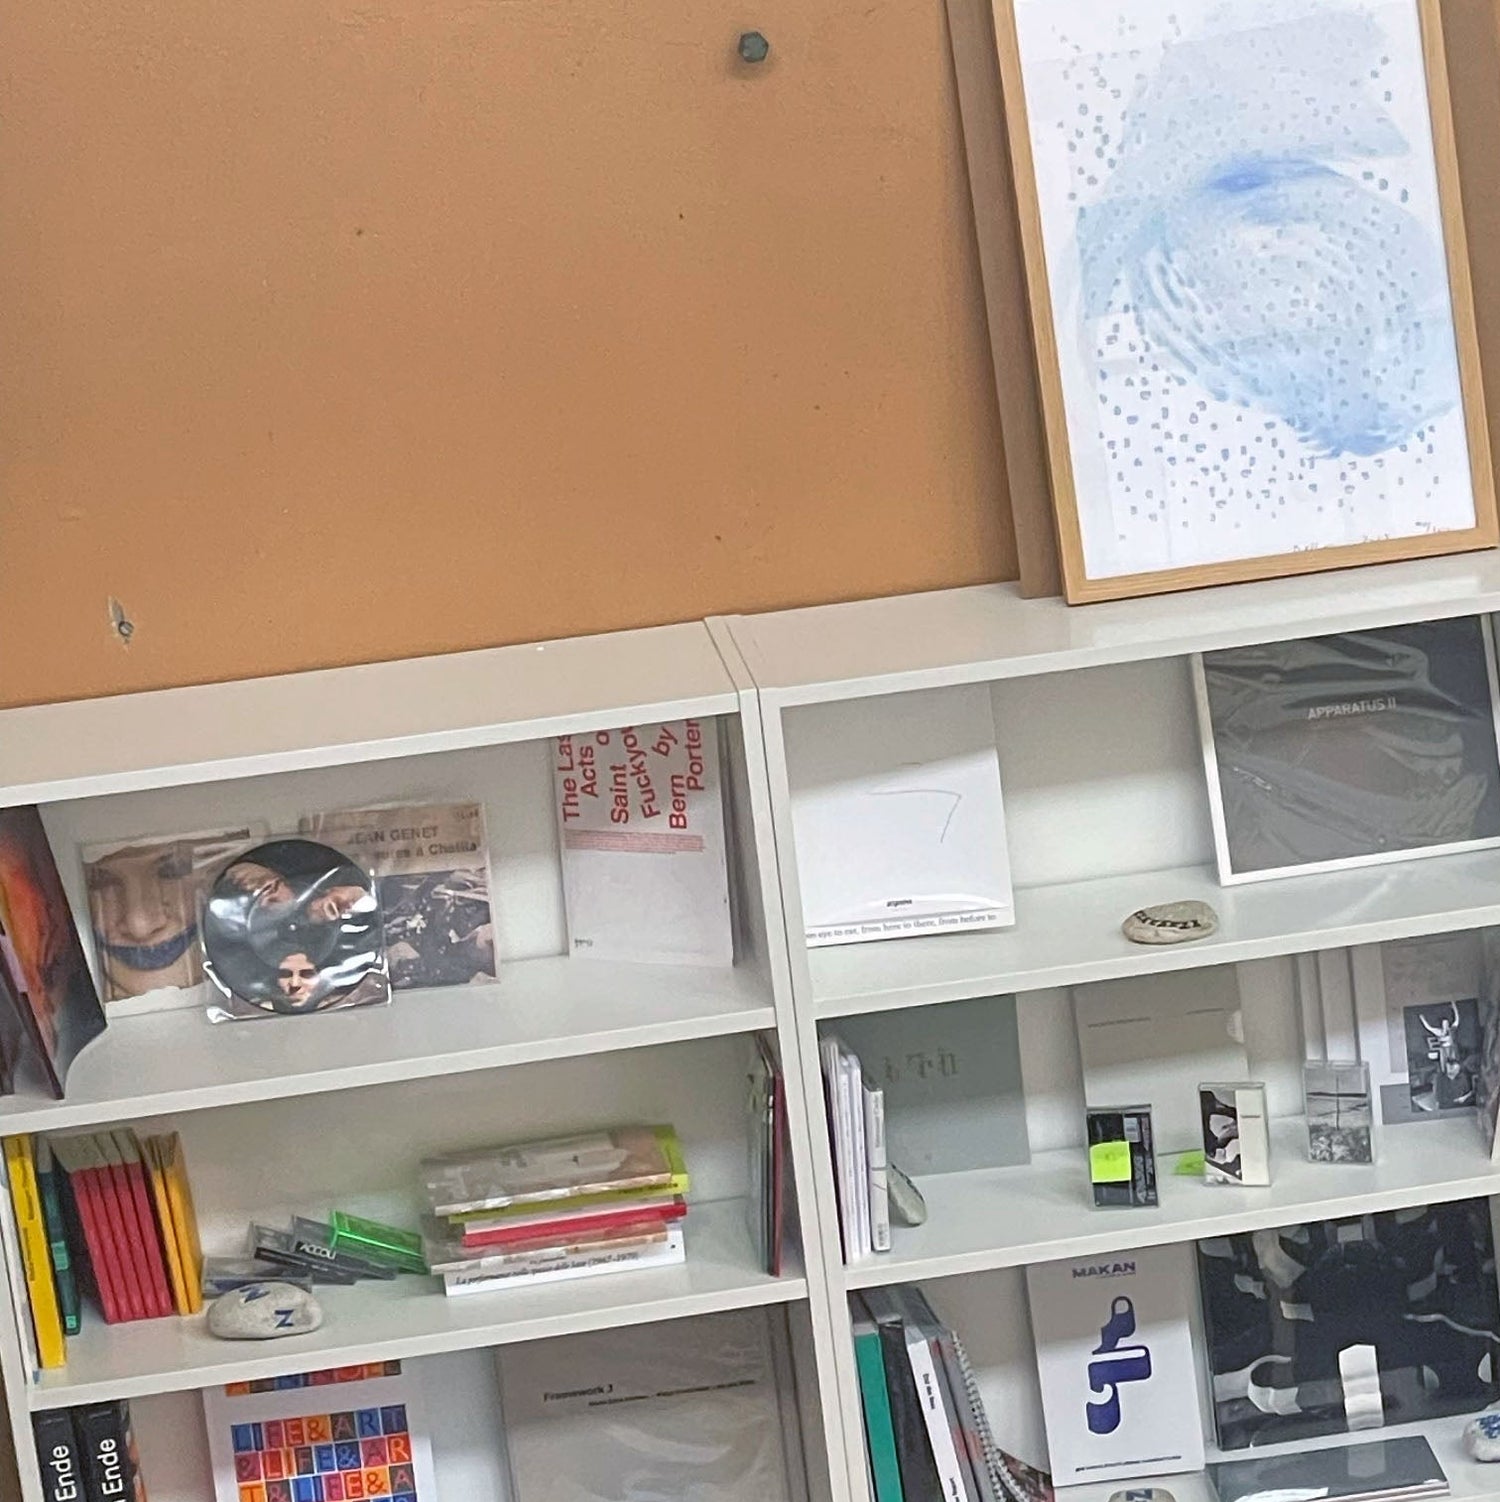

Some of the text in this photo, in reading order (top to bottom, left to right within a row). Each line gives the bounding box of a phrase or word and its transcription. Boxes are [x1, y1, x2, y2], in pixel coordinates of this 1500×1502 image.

[1308, 700, 1385, 720] APPARATUS
[651, 726, 678, 757] by
[558, 735, 580, 822] The Las
[578, 746, 599, 798] Acts
[610, 764, 629, 824] Saint
[669, 775, 687, 829] Bern
[390, 826, 438, 840] GENET
[1072, 1261, 1136, 1279] MAKAN
[50, 1445, 77, 1501] Ende
[97, 1438, 123, 1495] Ende
